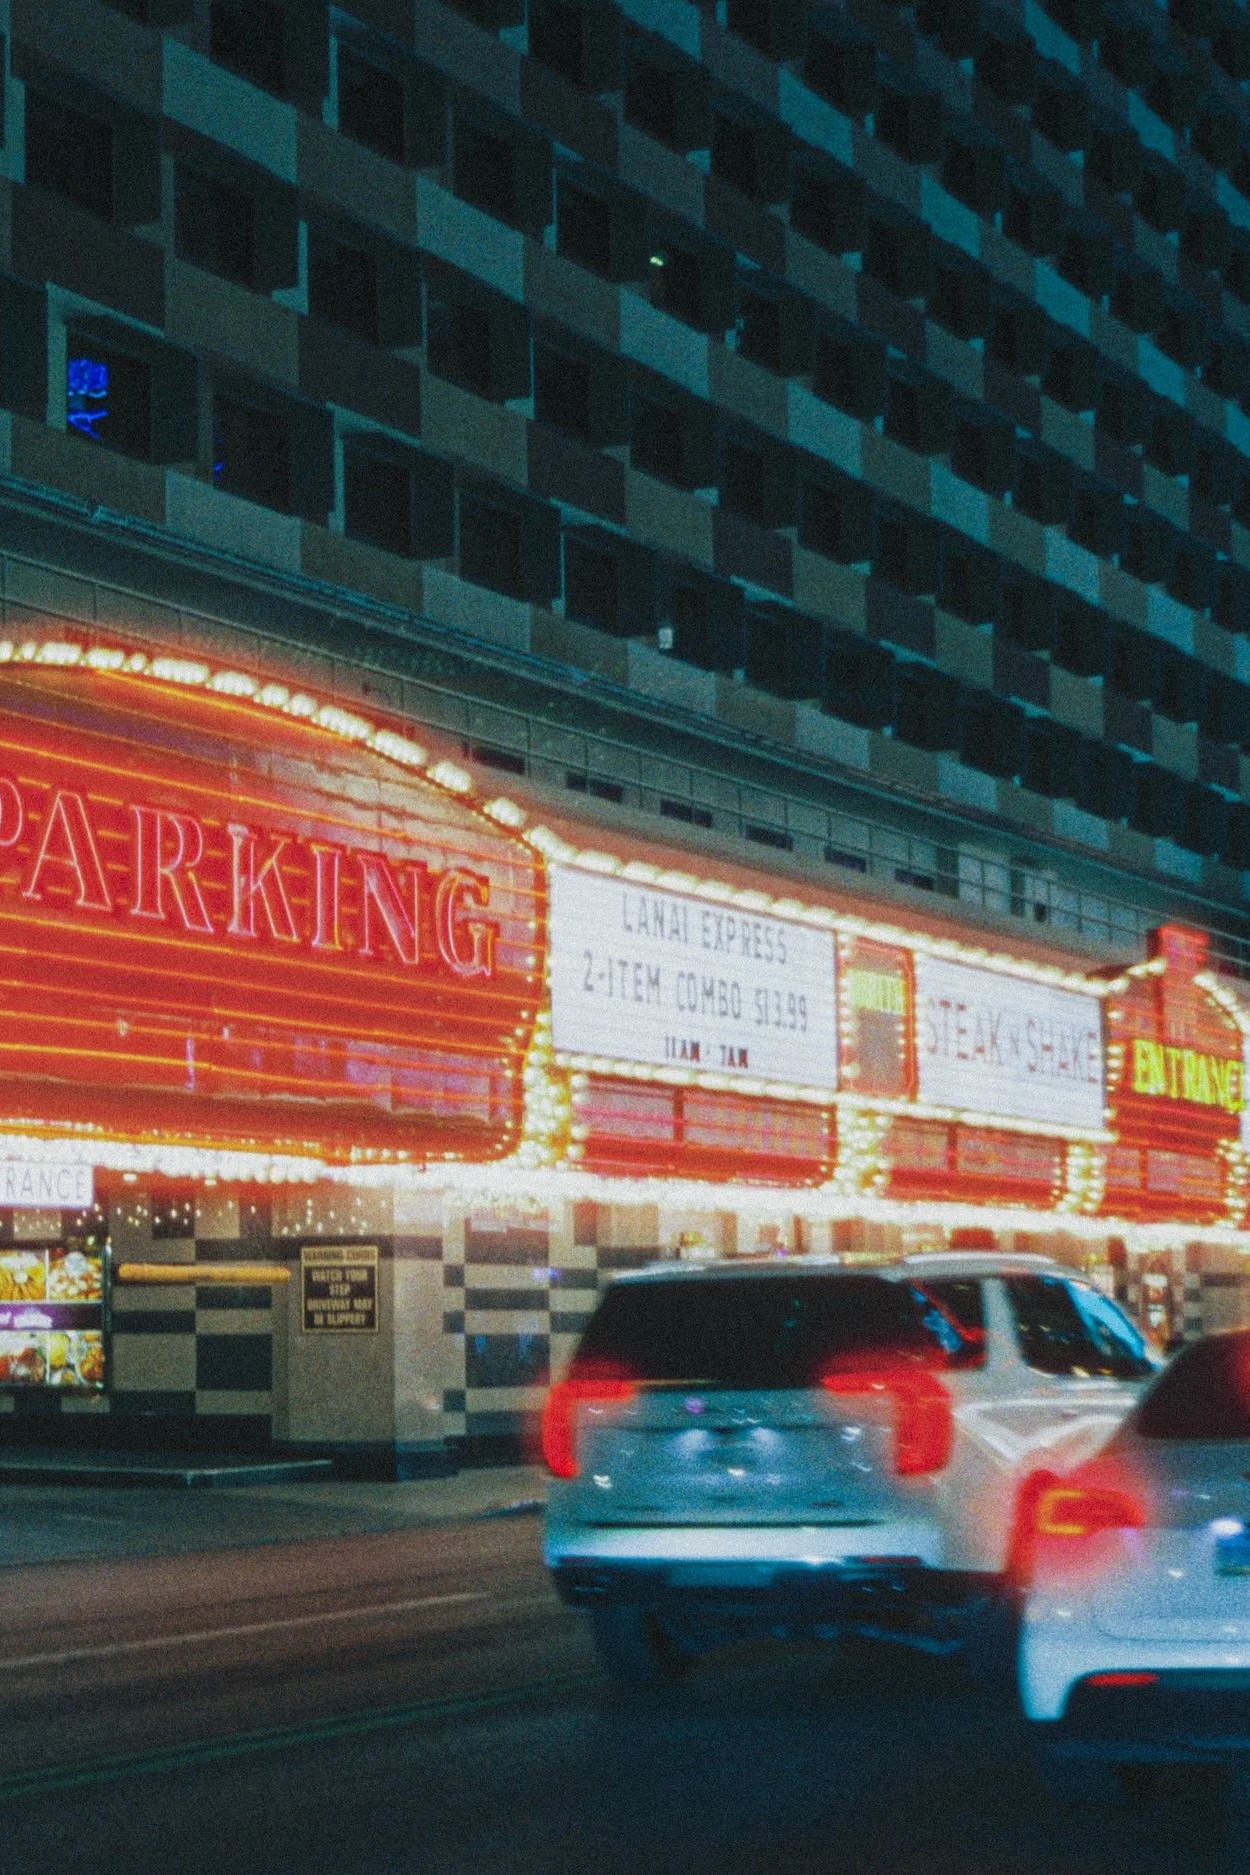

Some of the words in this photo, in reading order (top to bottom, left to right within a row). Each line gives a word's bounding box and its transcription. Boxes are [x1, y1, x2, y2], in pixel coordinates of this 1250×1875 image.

[621, 892, 690, 945] LANAI
[701, 909, 788, 966] EXPRESS
[581, 947, 662, 1010] 2-ITEM
[675, 970, 742, 1021] COMBO
[924, 998, 1004, 1067] STEAK
[1026, 1017, 1099, 1084] SHAKE
